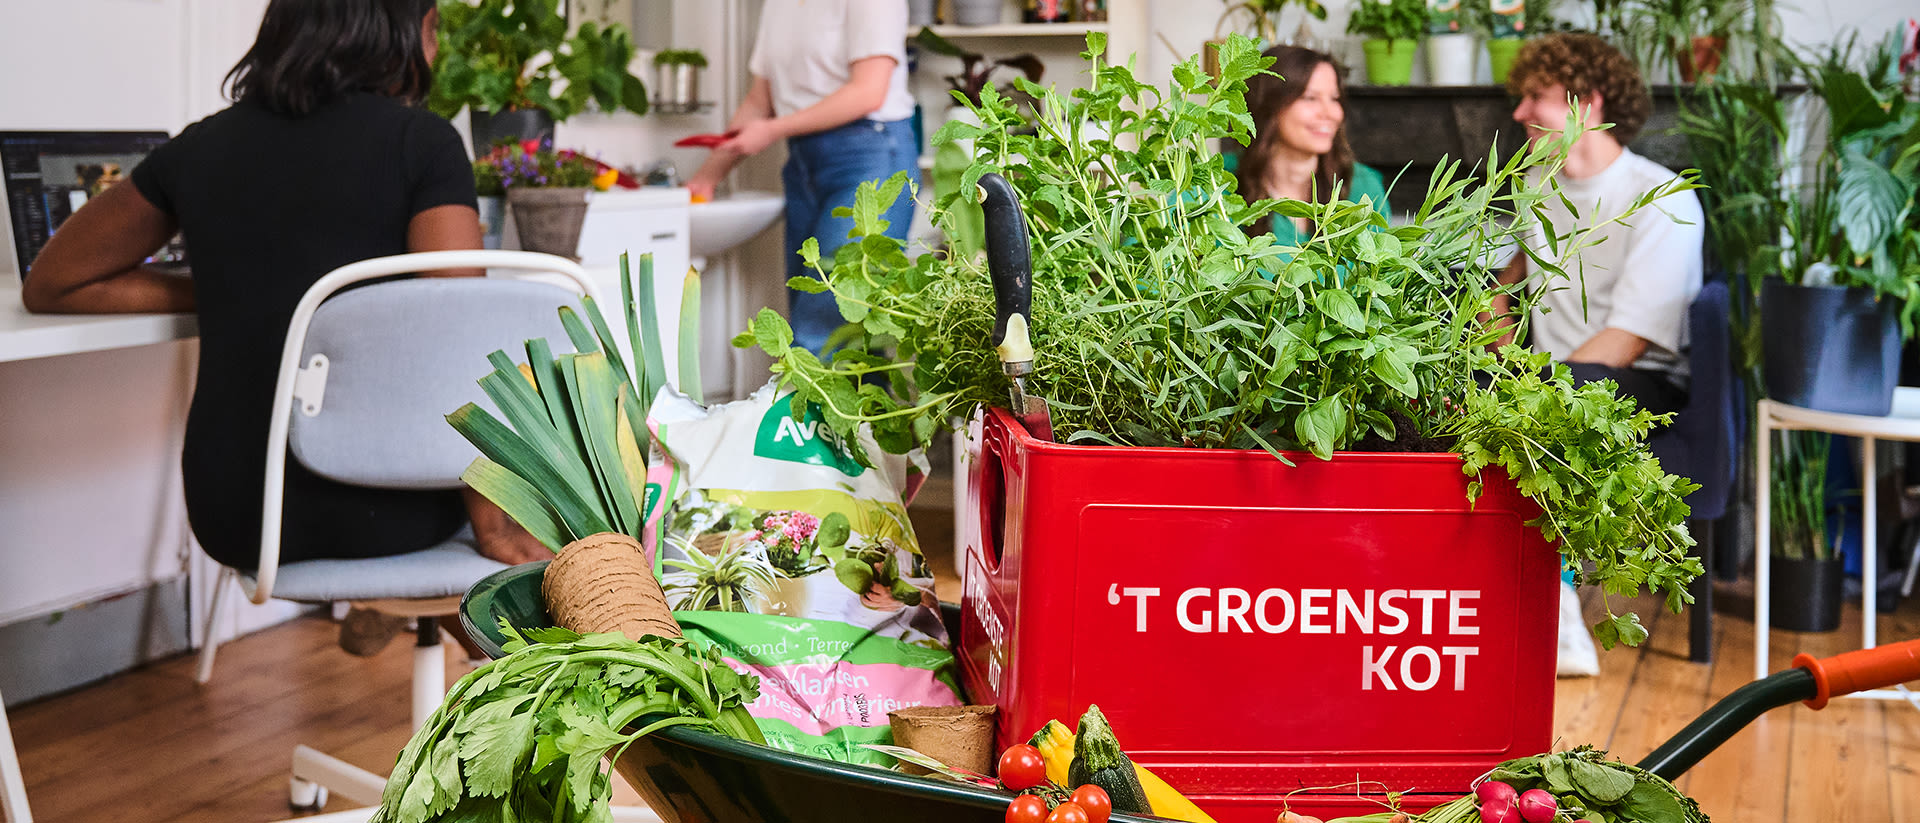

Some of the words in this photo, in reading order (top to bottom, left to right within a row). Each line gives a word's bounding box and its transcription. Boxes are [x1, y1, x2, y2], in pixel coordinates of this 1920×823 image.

[1107, 583, 1160, 632] ‘T
[1176, 587, 1480, 635] GROENSTE
[988, 650, 1001, 698] KOT
[1362, 646, 1479, 691] KOT
